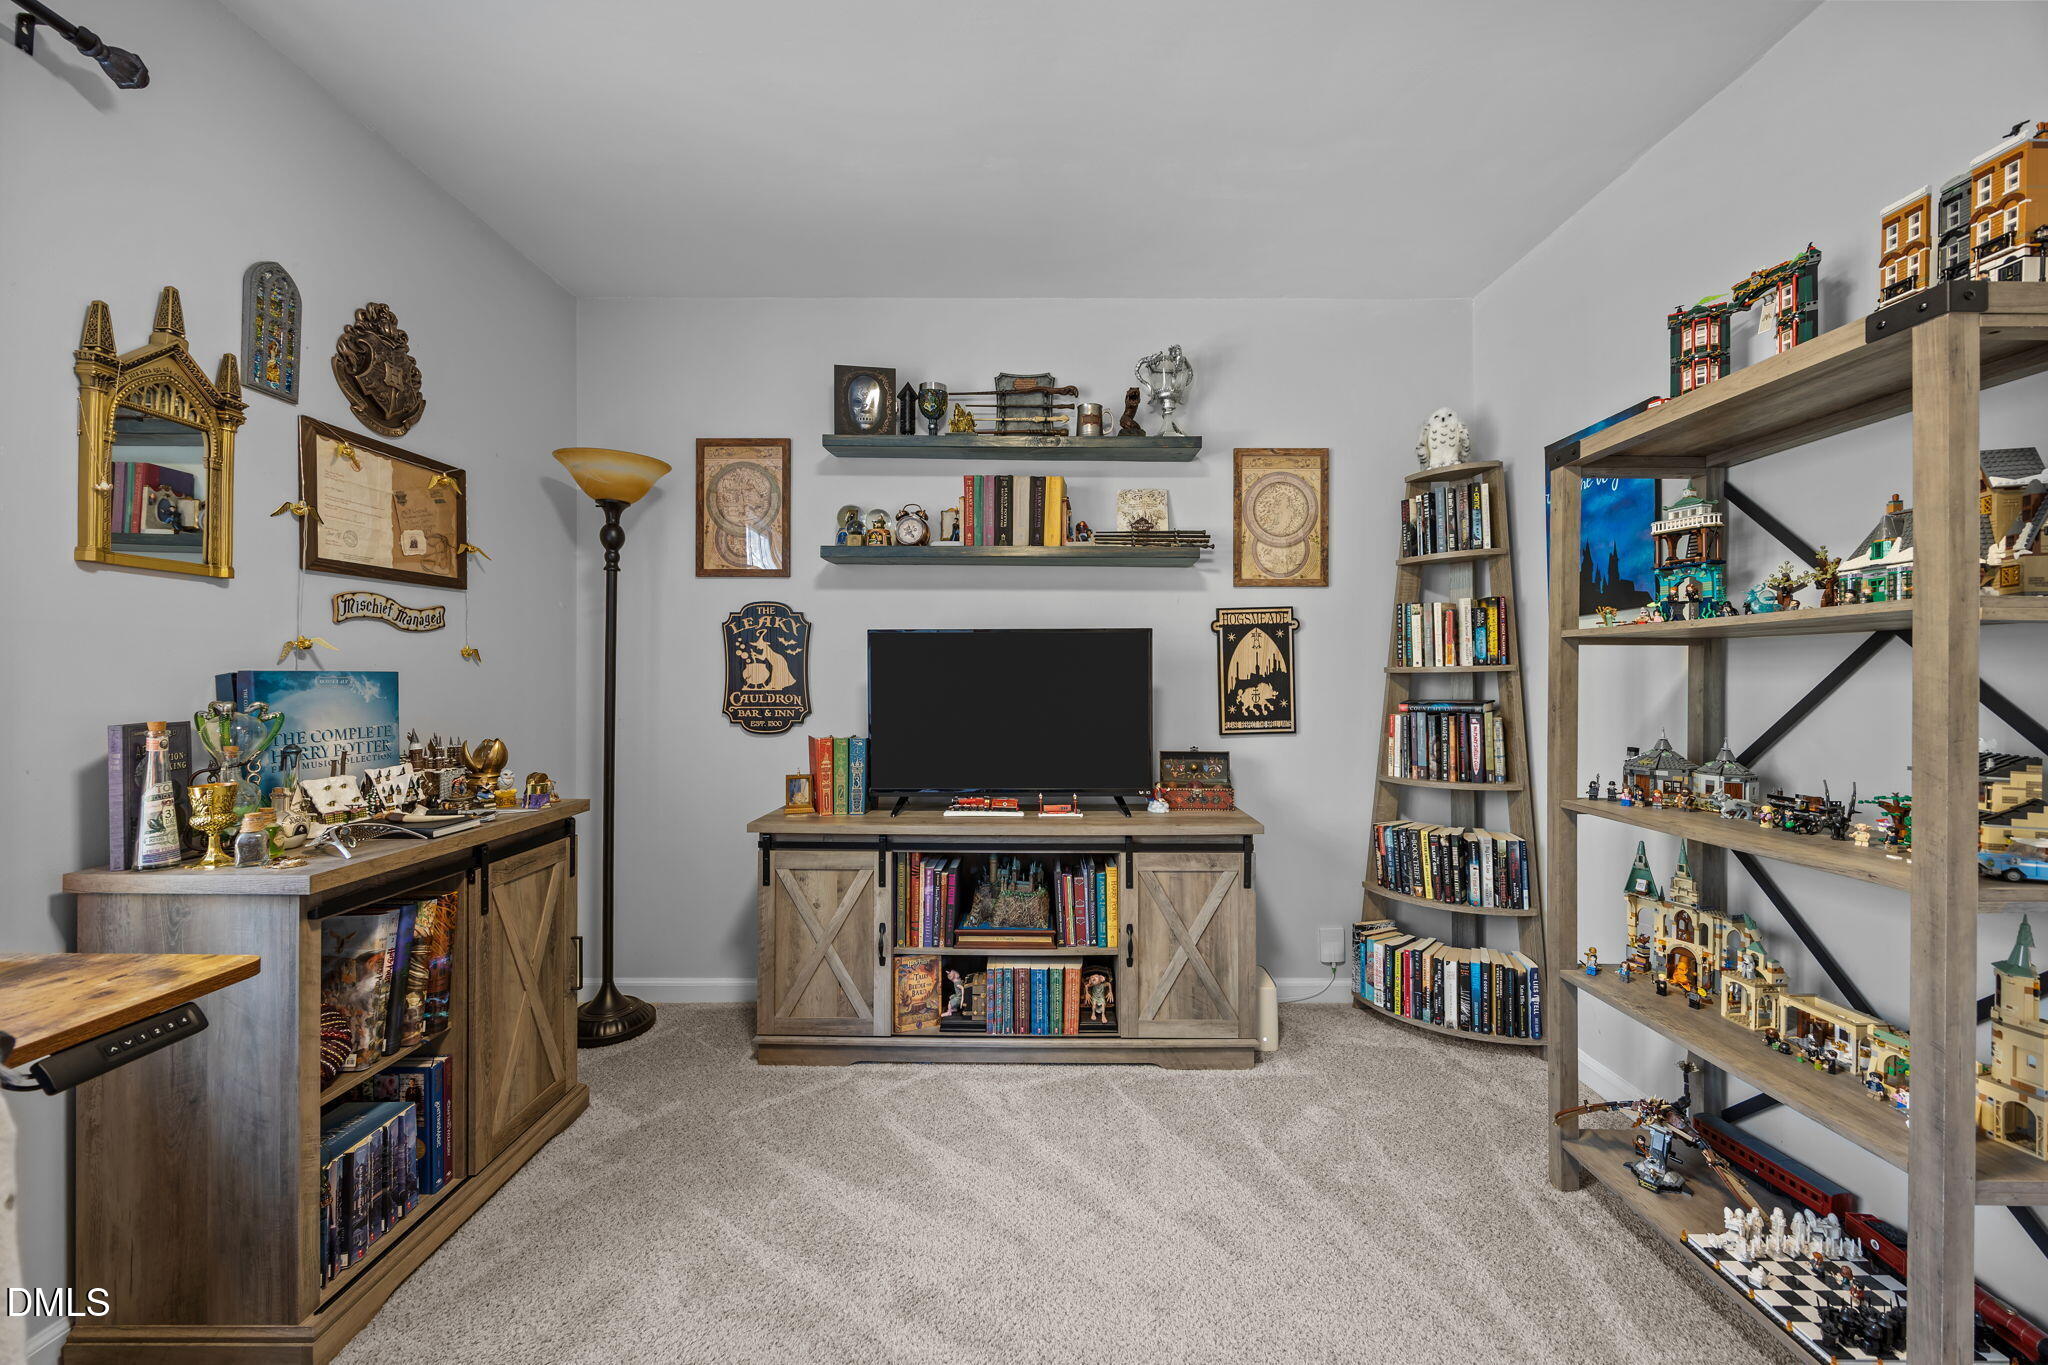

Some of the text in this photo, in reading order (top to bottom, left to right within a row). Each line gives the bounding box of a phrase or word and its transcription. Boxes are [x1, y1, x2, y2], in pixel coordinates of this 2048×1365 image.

[340, 597, 443, 629] Mischief Managed
[756, 606, 776, 615] THE
[1221, 612, 1290, 626] HOGSMEADE
[729, 615, 801, 637] LEAKY
[729, 691, 803, 707] CAULDRON
[738, 708, 796, 718] BAR & INN
[750, 720, 767, 728] EST.
[274, 725, 392, 747] THE COMPLETE
[271, 739, 391, 764] HRRY POTTER
[1411, 839, 1419, 859] BOOK
[1413, 859, 1421, 880] THIEF
[1110, 881, 1118, 898] HARRY
[384, 947, 396, 965] Harry
[1532, 980, 1540, 992] LIES
